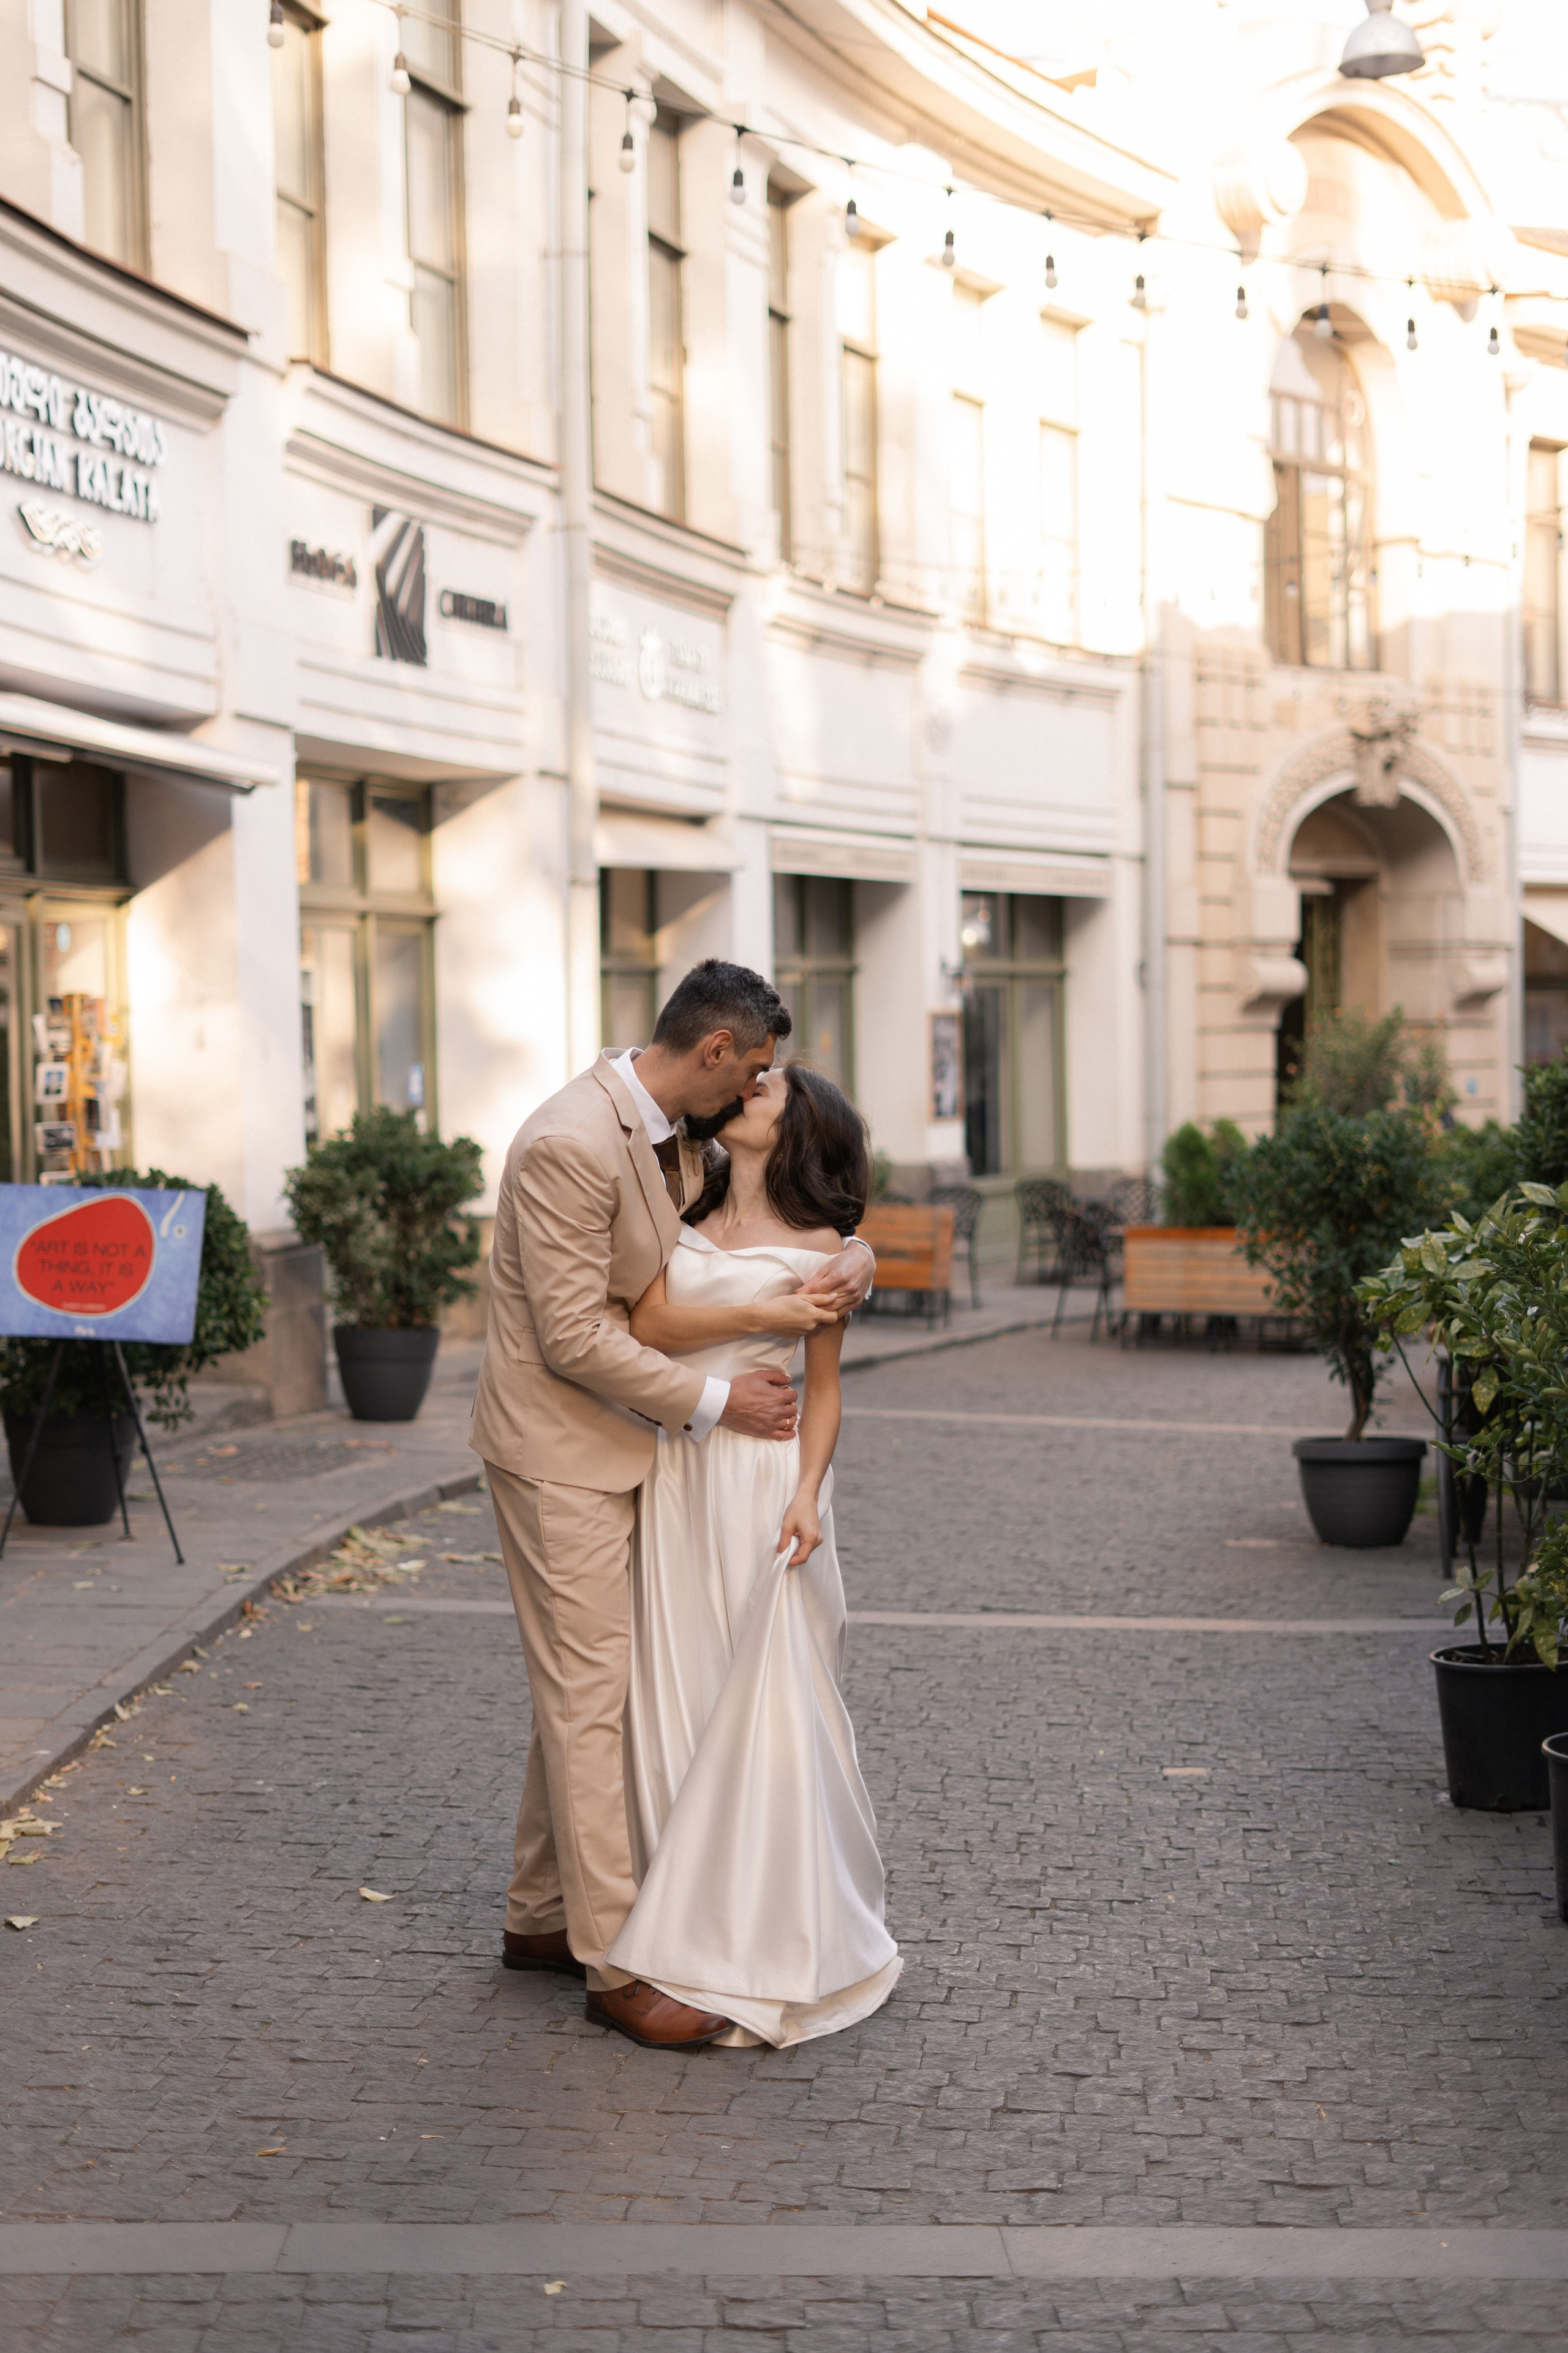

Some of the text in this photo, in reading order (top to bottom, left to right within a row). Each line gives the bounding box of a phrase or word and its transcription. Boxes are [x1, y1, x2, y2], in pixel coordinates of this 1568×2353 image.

[77, 450, 159, 522] KALATA
[74, 1241, 88, 1255] IS
[93, 1242, 129, 1258] NOT
[134, 1244, 147, 1258] A
[99, 1261, 114, 1274] IT
[119, 1262, 134, 1277] IS
[52, 1278, 64, 1293] A
